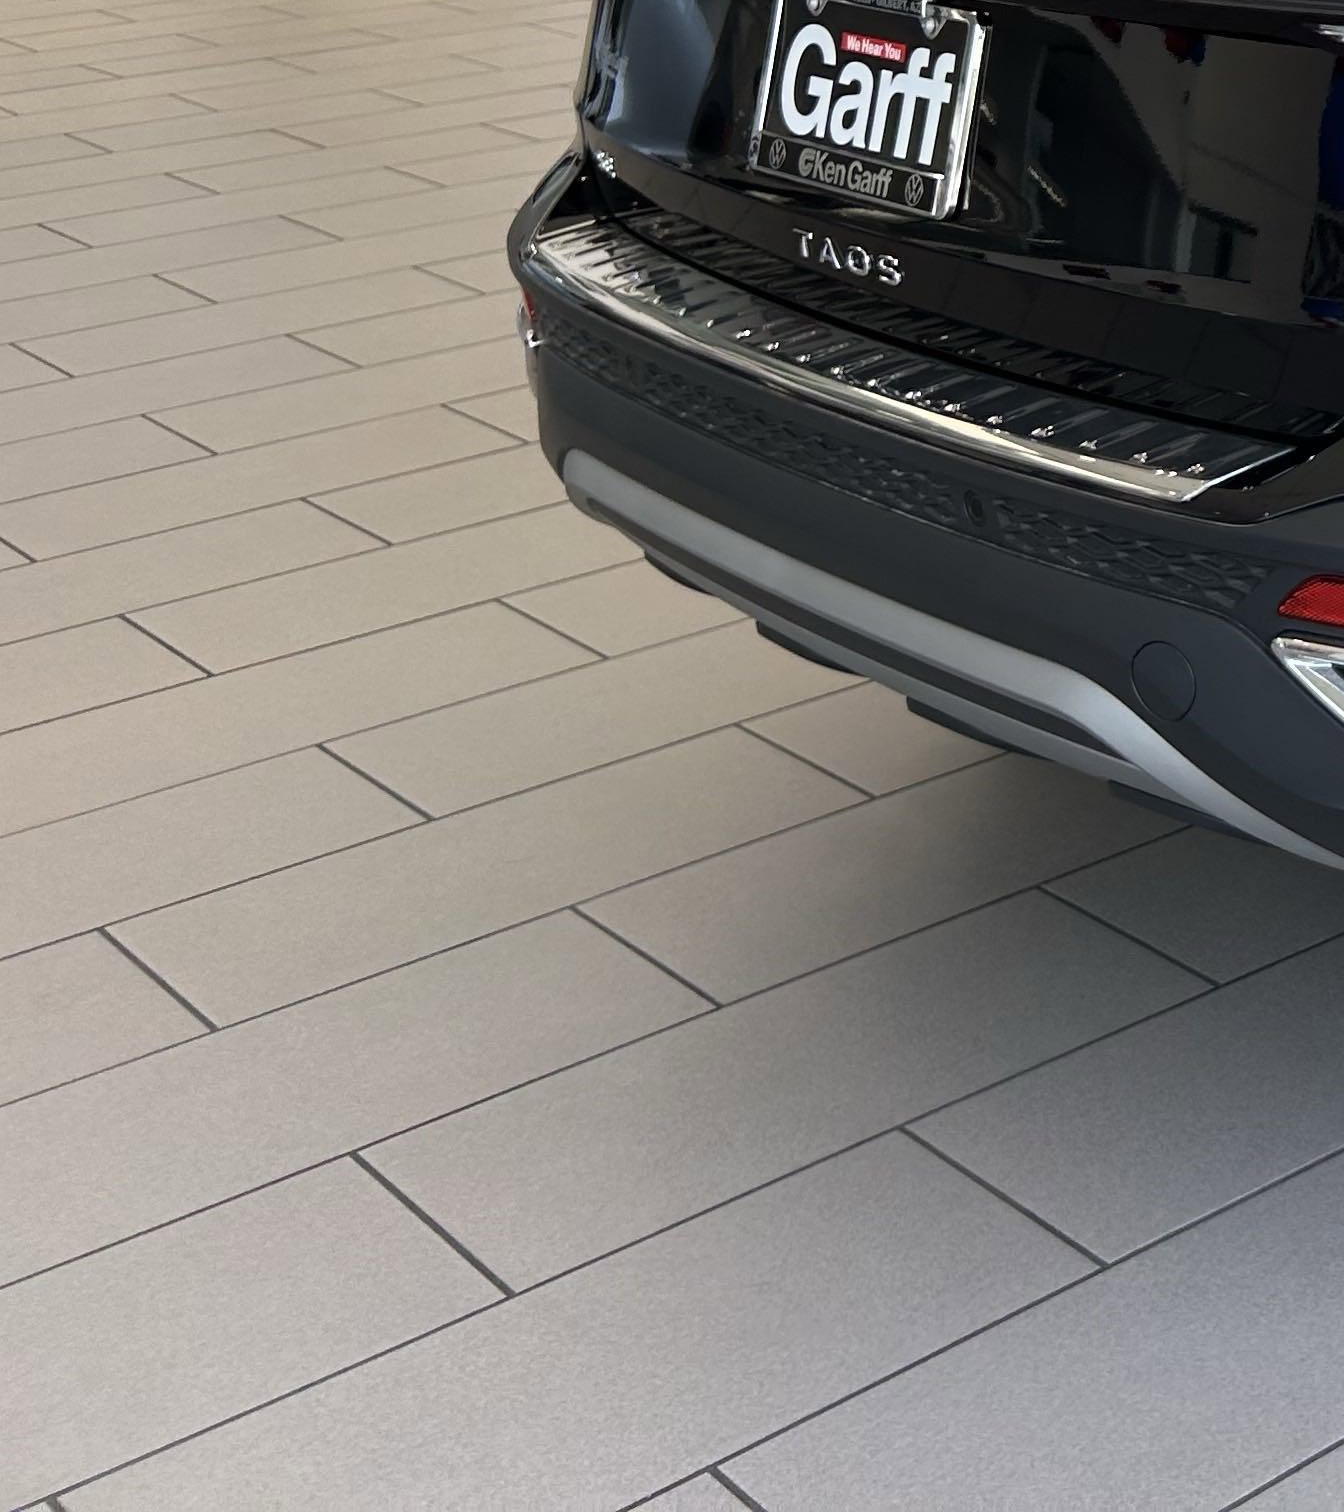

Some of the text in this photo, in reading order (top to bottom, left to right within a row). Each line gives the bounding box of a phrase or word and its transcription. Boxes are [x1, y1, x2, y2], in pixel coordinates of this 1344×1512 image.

[846, 35, 901, 61] We Hear You
[782, 24, 957, 167] Garff
[812, 150, 893, 198] Ken Garff
[792, 228, 905, 287] TAOS
